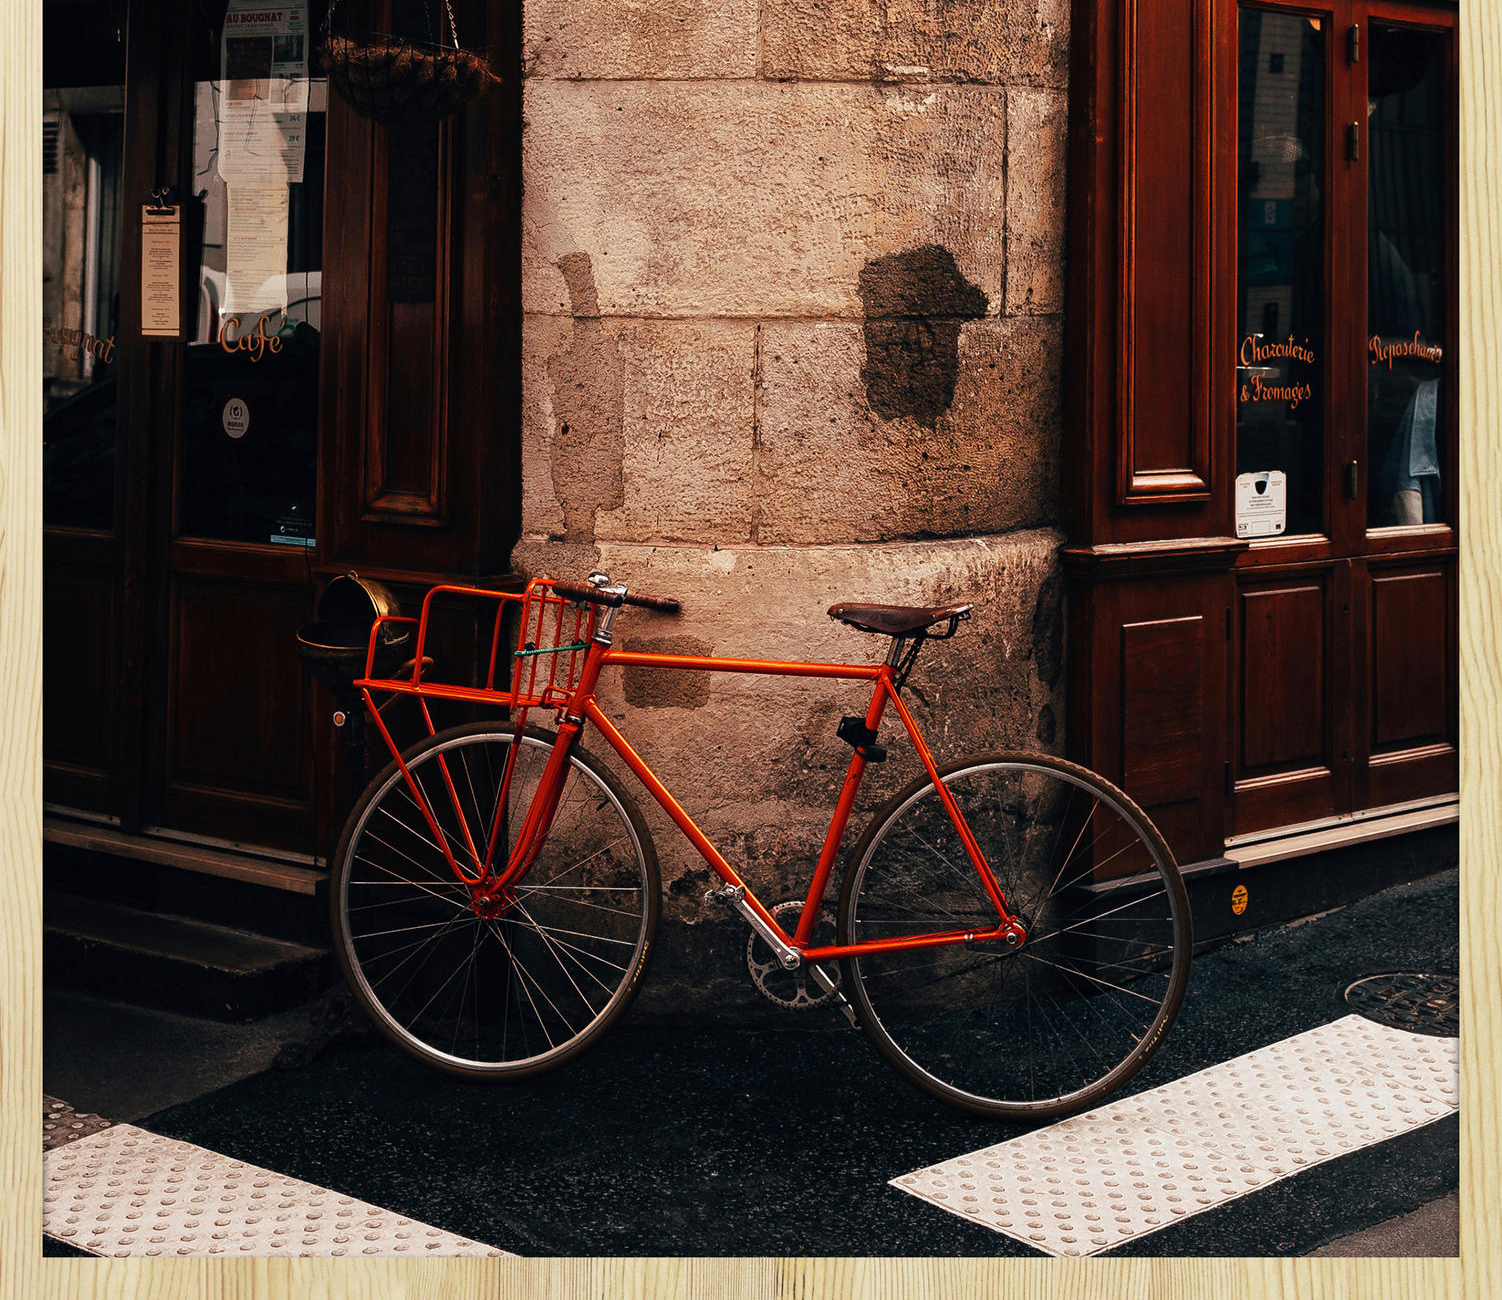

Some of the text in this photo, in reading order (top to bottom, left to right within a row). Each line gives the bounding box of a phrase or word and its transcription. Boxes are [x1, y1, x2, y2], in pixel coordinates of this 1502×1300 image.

[226, 13, 239, 24] AU
[240, 11, 283, 24] BOUGNAT
[220, 315, 286, 363] Café
[1240, 333, 1315, 366] Charcuterie
[1240, 371, 1312, 410] & Fromages
